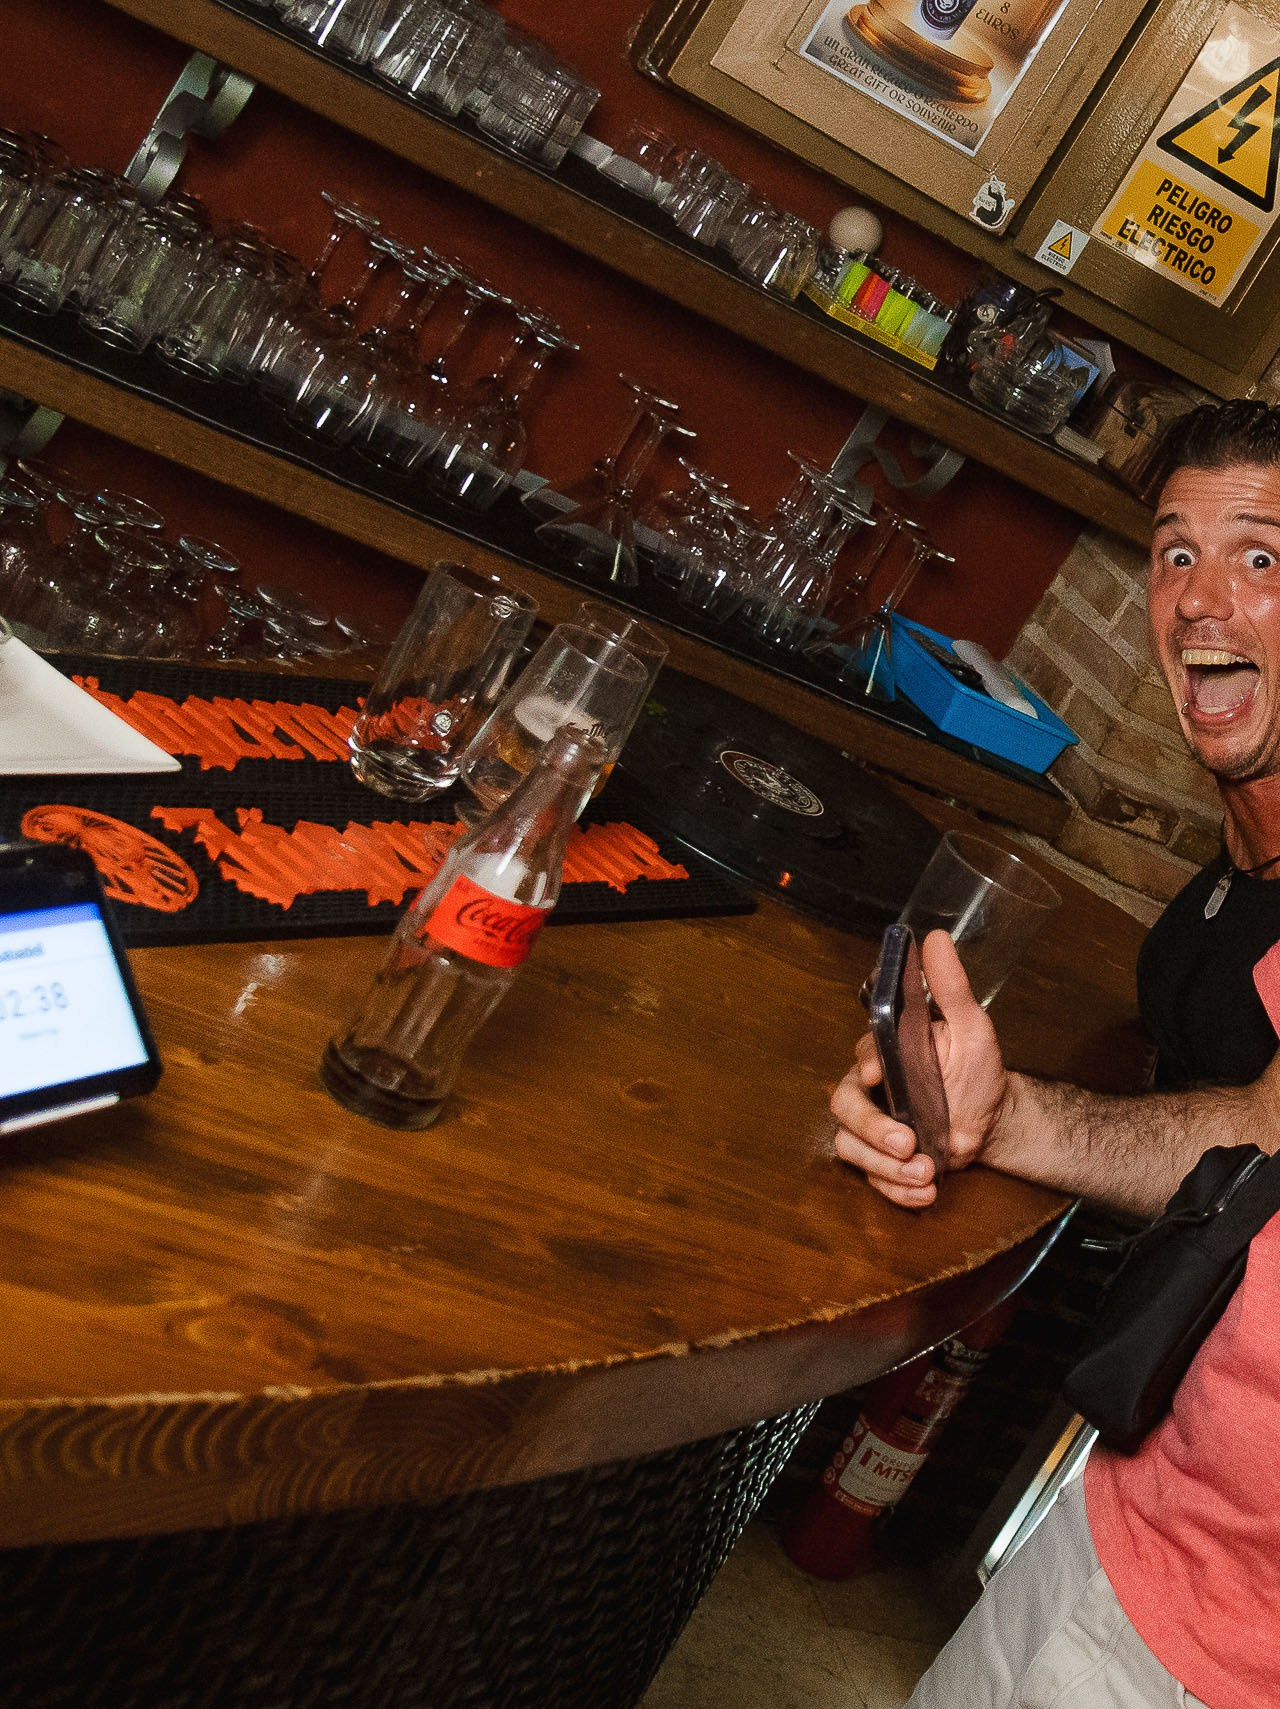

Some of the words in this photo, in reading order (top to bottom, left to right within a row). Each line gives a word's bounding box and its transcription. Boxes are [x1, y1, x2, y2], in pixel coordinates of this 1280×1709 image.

[975, 8, 1020, 40] EUROS
[1000, 1, 1010, 14] 8
[824, 35, 841, 50] UN
[829, 54, 865, 84] GREAT
[864, 73, 889, 94] GIFT
[889, 89, 905, 105] OR
[905, 99, 957, 134] SOUVENIR
[1146, 203, 1215, 254] RIESGO
[1155, 178, 1233, 234] PELIGRO
[1117, 217, 1216, 285] ELECTRICO
